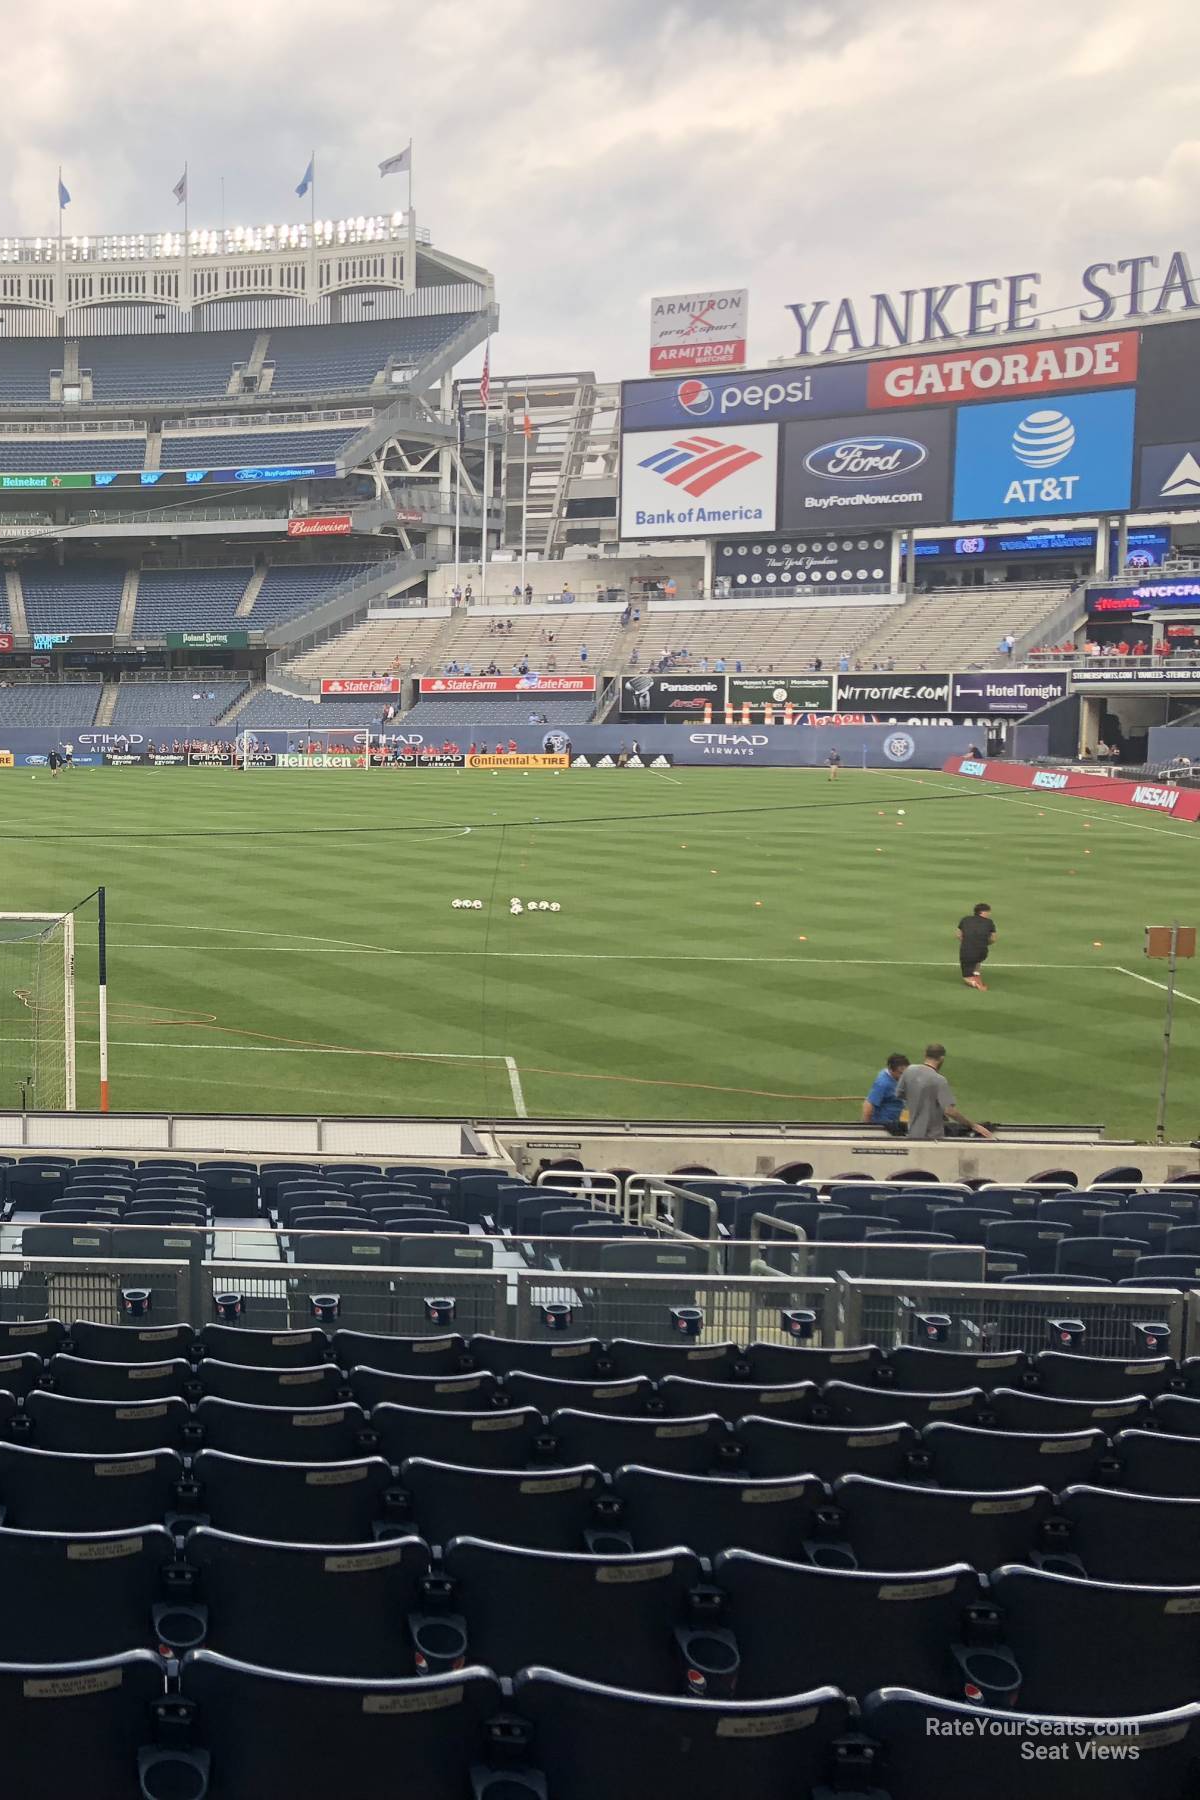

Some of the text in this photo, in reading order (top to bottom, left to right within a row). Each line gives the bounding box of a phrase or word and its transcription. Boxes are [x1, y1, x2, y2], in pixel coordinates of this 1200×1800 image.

[655, 297, 741, 316] ARMITRON
[785, 272, 1041, 358] YANKEE
[657, 343, 736, 360] ARMITRON
[884, 342, 1120, 398] GATORADE
[720, 376, 811, 414] pepsi
[827, 443, 902, 474] Ford
[95, 475, 112, 485] SAP
[141, 474, 158, 484] SAP
[186, 473, 204, 482] SAP
[264, 468, 315, 477] BuyFordNow.com
[3, 477, 47, 487] Heineken
[1004, 476, 1080, 504] AT&T
[805, 492, 922, 509] BuyFordNow.com
[635, 506, 763, 525] Bank of America
[289, 519, 349, 535] Budweiser
[660, 682, 718, 692] Panasonic
[838, 684, 949, 701] NITTOTIRE.COM
[78, 734, 144, 744] ETIHAD
[353, 734, 424, 745] ETIHAD
[690, 733, 769, 746] ETIHAD
[703, 747, 755, 756] AIRWAYS
[278, 755, 352, 769] Heineken
[469, 755, 566, 768] Continental TIRE
[1032, 771, 1069, 789] NISSAN
[1131, 786, 1180, 809] NISSAN
